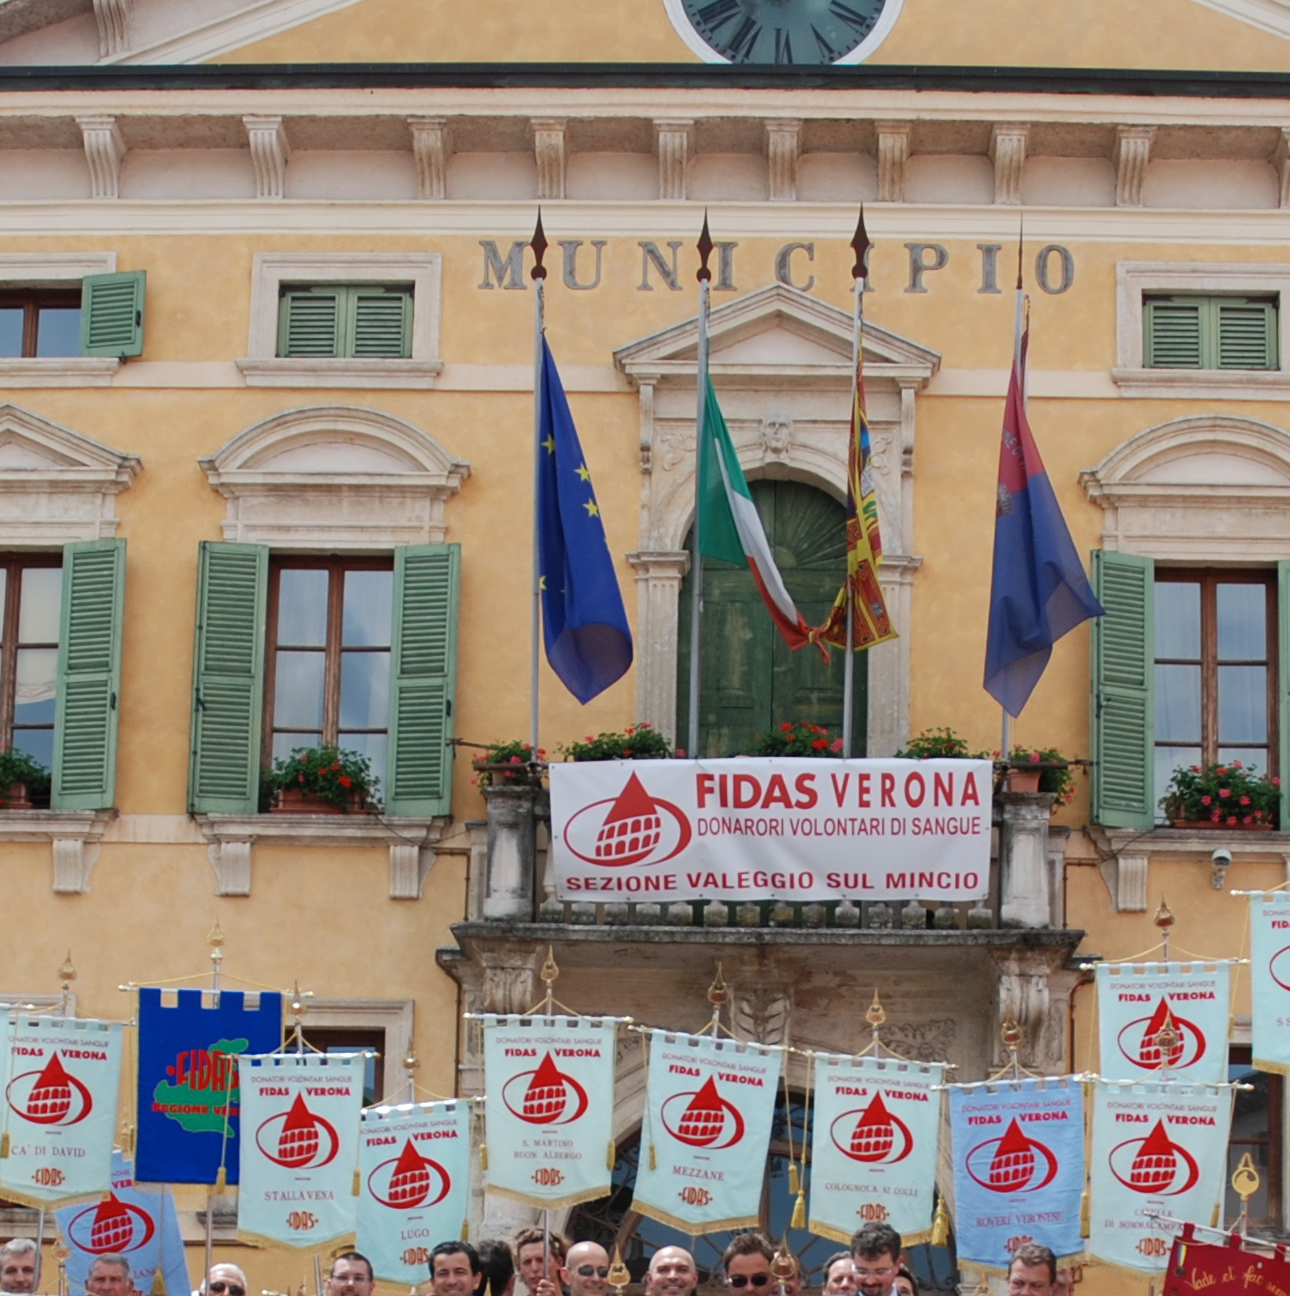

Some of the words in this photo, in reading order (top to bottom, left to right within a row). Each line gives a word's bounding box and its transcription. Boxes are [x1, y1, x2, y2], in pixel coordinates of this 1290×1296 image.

[477, 240, 1075, 294] MUNICIPIO
[696, 773, 818, 810] FIDAS
[831, 771, 980, 808] VERONA
[697, 816, 784, 837] DONARORI
[790, 816, 885, 836] VOLONTARI
[890, 817, 906, 835] DI
[911, 816, 981, 836] SANGUE
[565, 874, 677, 892] SEZIONE
[686, 871, 814, 890] VALEGGIO
[826, 872, 874, 890] SUL
[885, 871, 979, 890] MINCIO
[1118, 994, 1151, 1002] FIDAS
[1168, 991, 1215, 1001] VERONA
[534, 1139, 574, 1147] MARTINO
[35, 1146, 46, 1156] DI
[52, 1147, 85, 1158] DAVID
[673, 1166, 724, 1181] MEZZANE
[265, 1191, 333, 1200] STALLAVENA
[825, 1183, 877, 1192] COLOGNOLA
[894, 1187, 918, 1196] COLLI
[402, 1229, 429, 1240] LUGO
